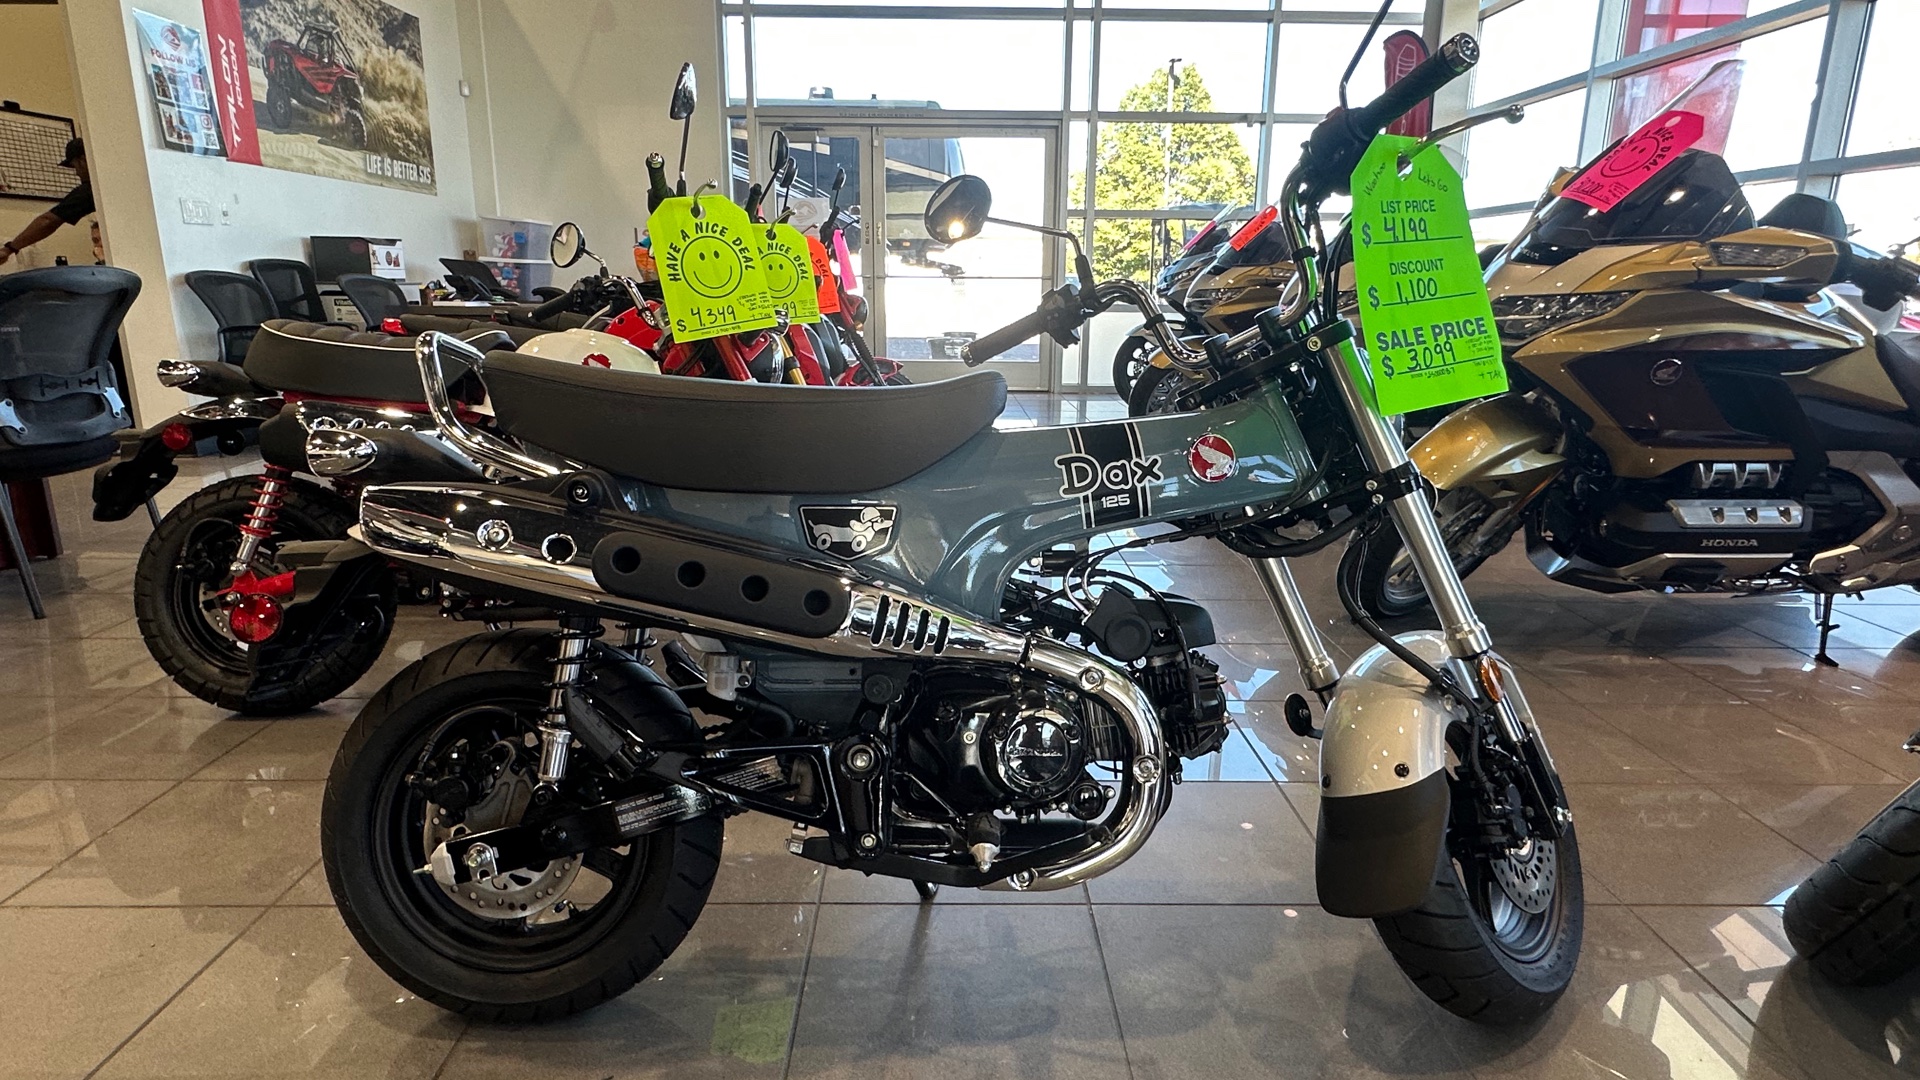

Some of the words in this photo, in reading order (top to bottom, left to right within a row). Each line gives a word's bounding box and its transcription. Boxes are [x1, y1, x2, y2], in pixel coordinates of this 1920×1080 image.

[150, 48, 184, 65] FOLLOW
[185, 58, 197, 68] US
[228, 38, 245, 109] 1000R
[217, 33, 242, 148] TALON
[1652, 126, 1674, 142] NICE
[366, 154, 382, 175] LIFE
[383, 157, 392, 177] IS
[393, 159, 418, 181] BETTER
[1642, 146, 1672, 171] DEAL
[1380, 200, 1402, 214] LIST
[1405, 199, 1436, 213] PRICE
[1362, 221, 1372, 248] $
[666, 242, 682, 282] HAVE
[679, 229, 690, 242] A
[694, 221, 729, 238] NICE
[731, 236, 756, 271] DEAL
[767, 242, 792, 255] NICE
[793, 254, 809, 280] DEAL
[815, 258, 829, 278] DEAL
[1389, 258, 1444, 276] DISCOUNT
[1367, 285, 1380, 311] $
[1396, 277, 1438, 305] 1,100
[676, 319, 687, 333] $
[1376, 326, 1426, 352] SALE
[1430, 316, 1488, 343] PRICE
[1381, 354, 1395, 380] $
[1054, 453, 1164, 498] Dax
[1101, 493, 1131, 509] 125
[1700, 539, 1759, 547] HONDA
